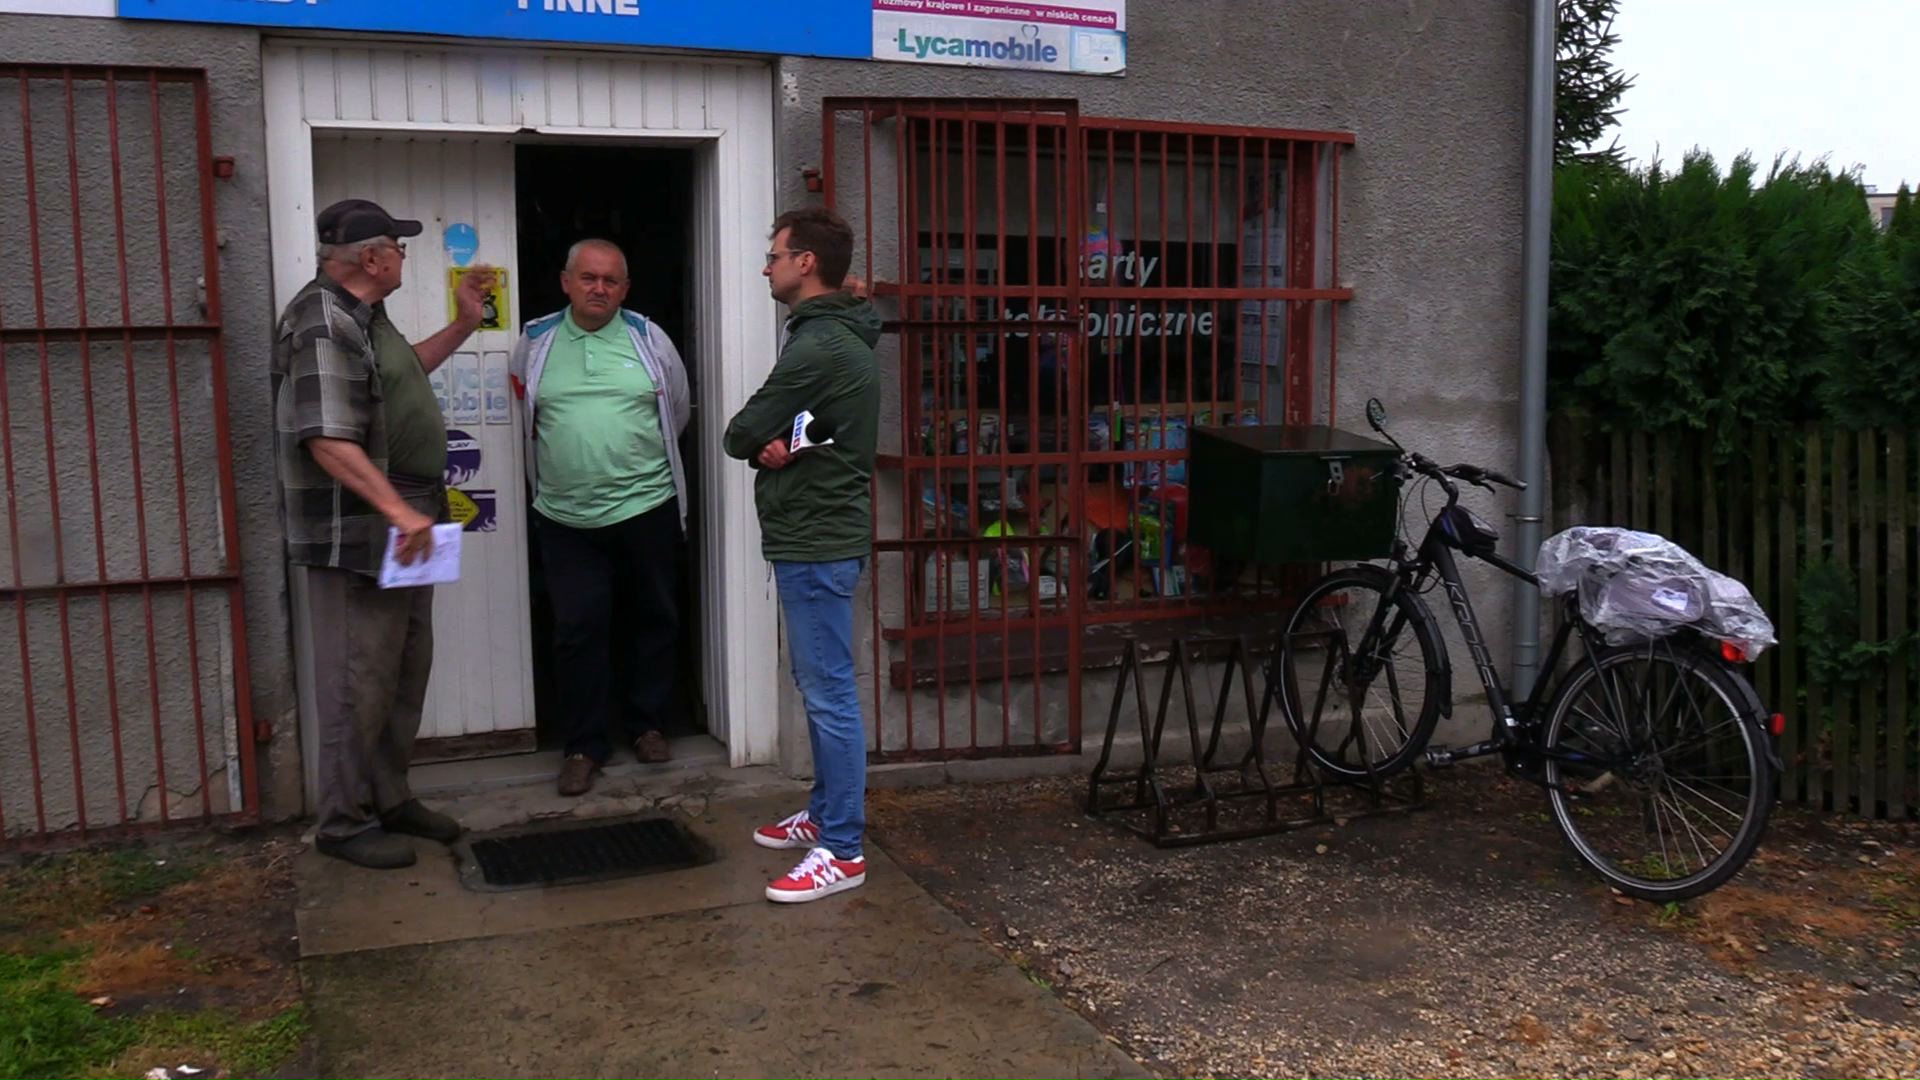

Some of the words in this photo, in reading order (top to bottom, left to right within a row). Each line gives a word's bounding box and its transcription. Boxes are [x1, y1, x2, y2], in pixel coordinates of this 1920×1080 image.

[926, 0, 965, 11] krajowe
[973, 5, 1031, 16] zagraniczne
[1046, 10, 1079, 21] niskich
[1081, 14, 1114, 24] cenach
[897, 27, 1058, 63] Lycamobile
[1004, 304, 1213, 338] teleoniczne
